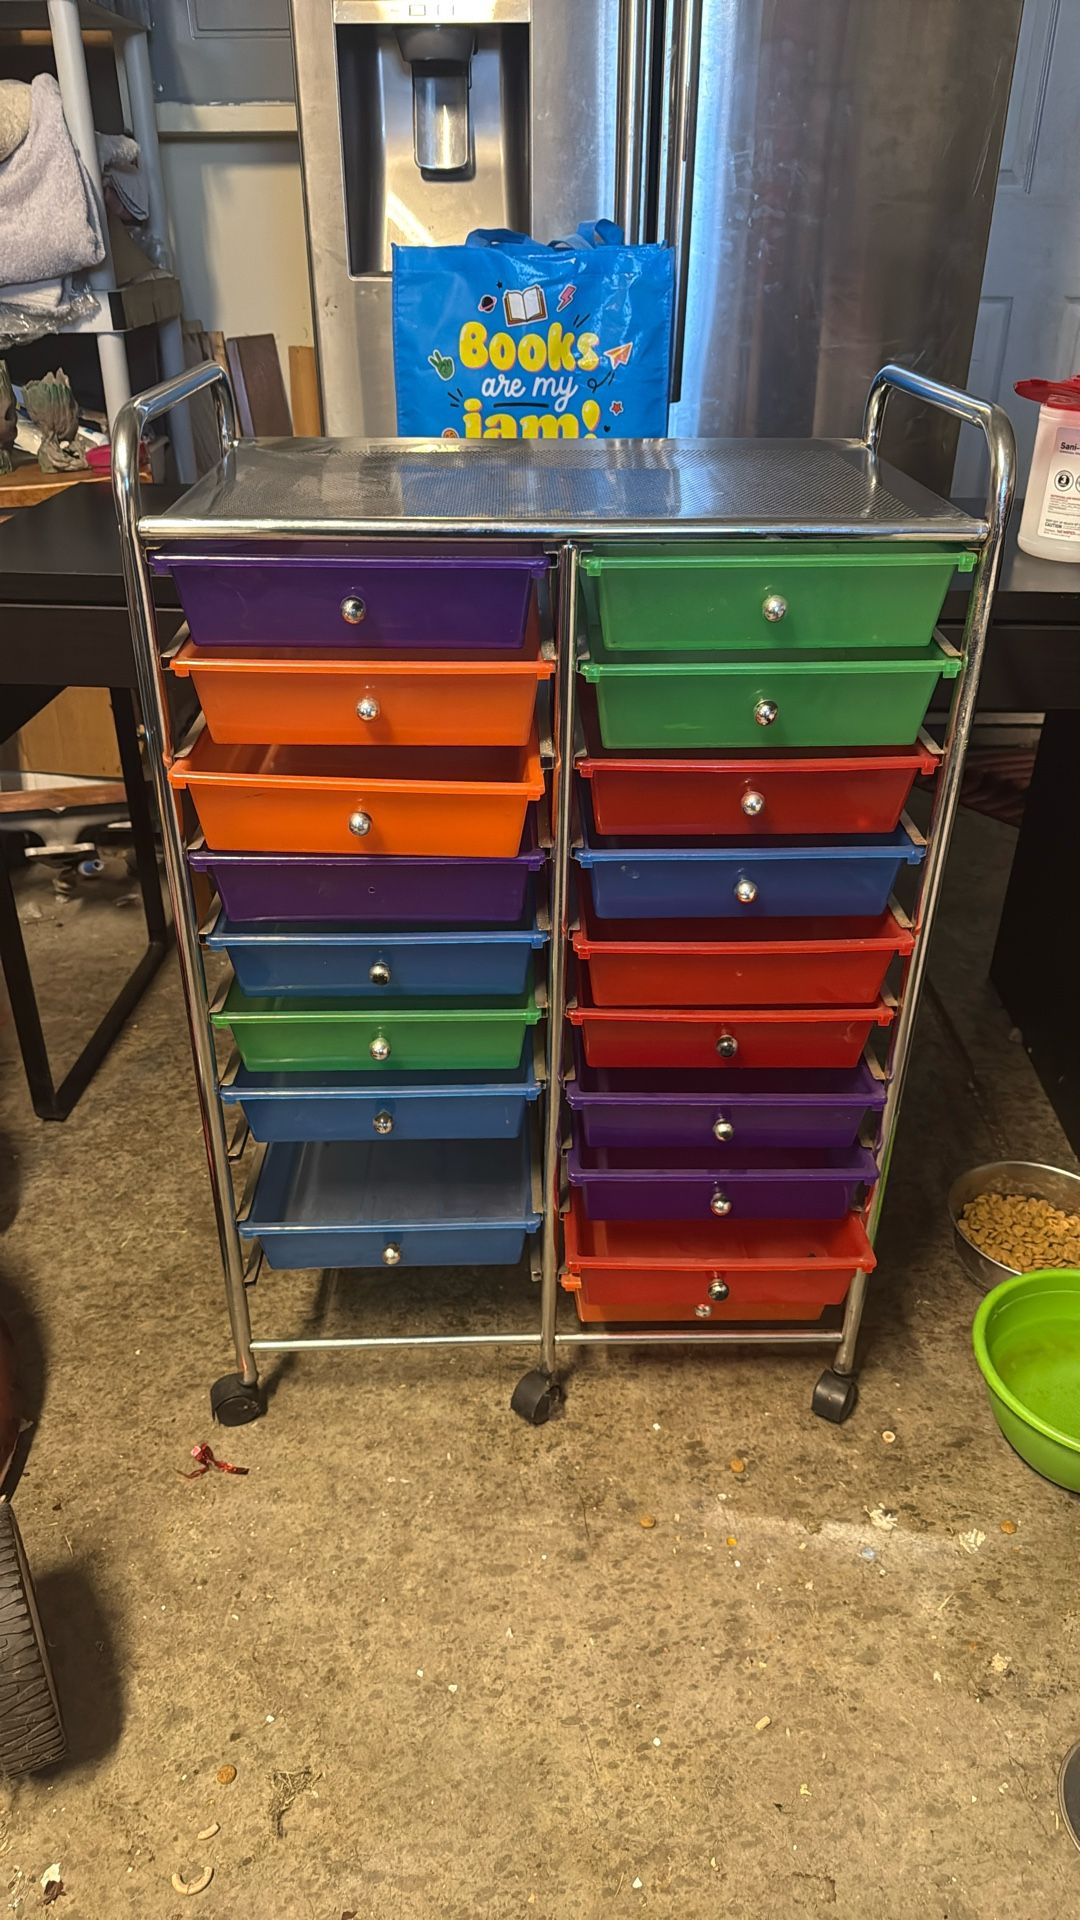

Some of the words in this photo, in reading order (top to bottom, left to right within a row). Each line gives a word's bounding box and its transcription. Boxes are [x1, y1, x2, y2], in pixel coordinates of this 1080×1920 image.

[459, 321, 600, 372] Books
[481, 374, 526, 397] are
[532, 376, 579, 412] my
